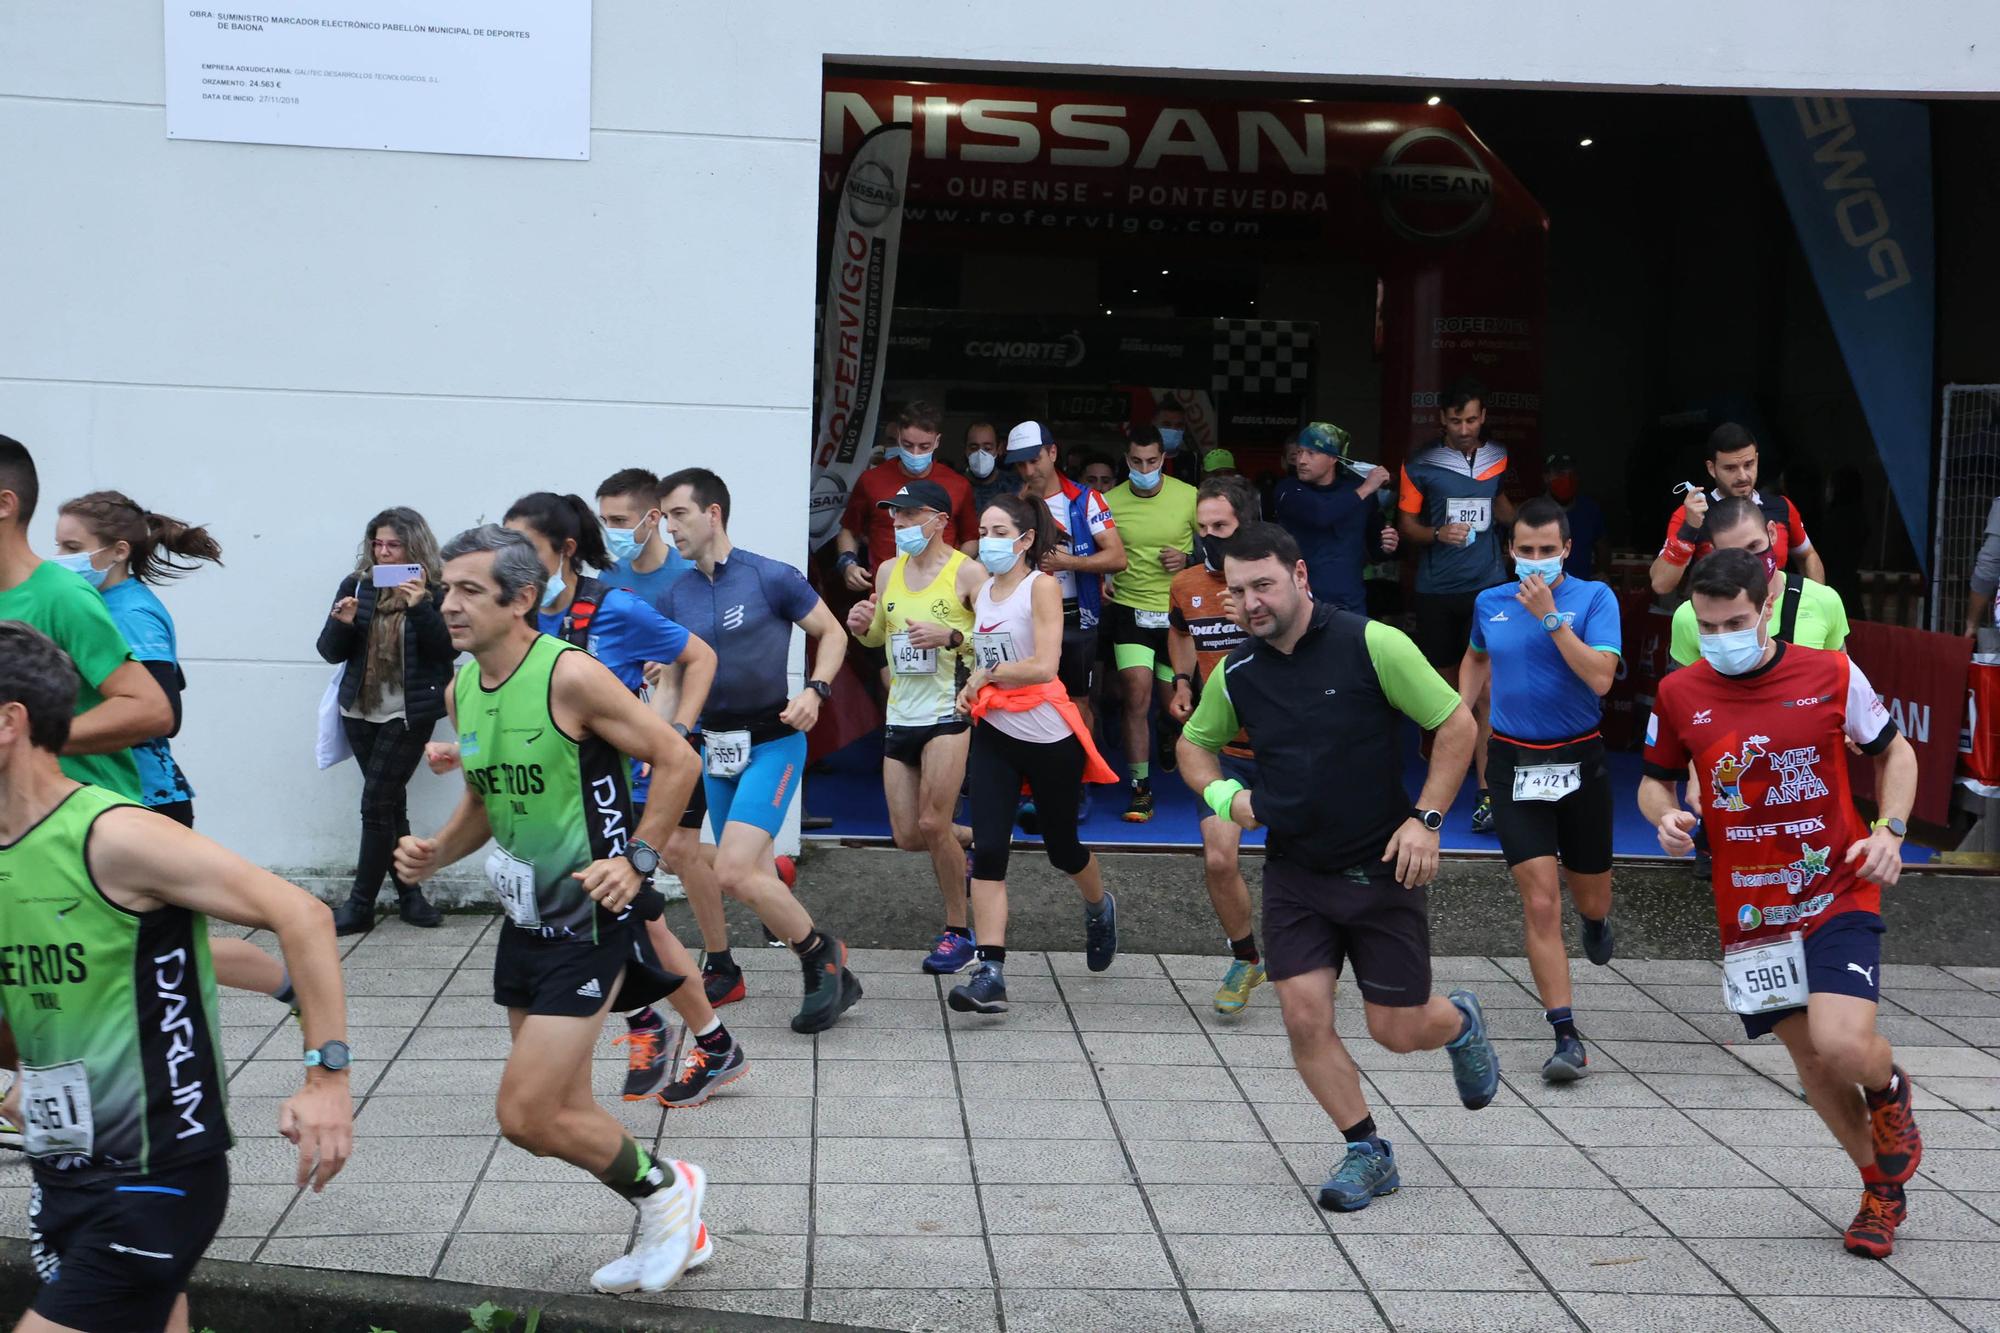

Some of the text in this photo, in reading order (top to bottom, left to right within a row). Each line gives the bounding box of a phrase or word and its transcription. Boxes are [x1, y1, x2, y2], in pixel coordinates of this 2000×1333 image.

[217, 13, 269, 23] SUMINISTRO
[271, 17, 320, 26] MARCADOR
[322, 19, 381, 30] ELECTRÓNICO
[382, 22, 426, 32] PABELLÓN
[428, 25, 472, 36] MUNICIPAL
[473, 28, 485, 36] DE
[486, 29, 531, 39] DEPORTES
[217, 22, 264, 32] DE BAIONA
[201, 63, 235, 72] EMPRESA
[324, 71, 373, 80] DESARROLLOS
[249, 80, 275, 88] 24.563
[823, 90, 1327, 176] NISSAN
[848, 180, 897, 202] NISSAN
[1379, 172, 1491, 194] NISSAN
[946, 177, 1088, 204] OURENSE
[1127, 186, 1329, 213] PONTEVEDRA
[855, 351, 875, 412] OURENSE
[1460, 509, 1477, 522] 812
[900, 646, 919, 662] 484
[982, 647, 1000, 662] 815
[1796, 697, 1818, 707] OCR
[1769, 746, 1820, 771] MEL
[1780, 764, 1816, 785] DA
[1765, 777, 1829, 805] ANTA
[1745, 965, 1788, 993] 596
[154, 947, 206, 1140] DARLIM
